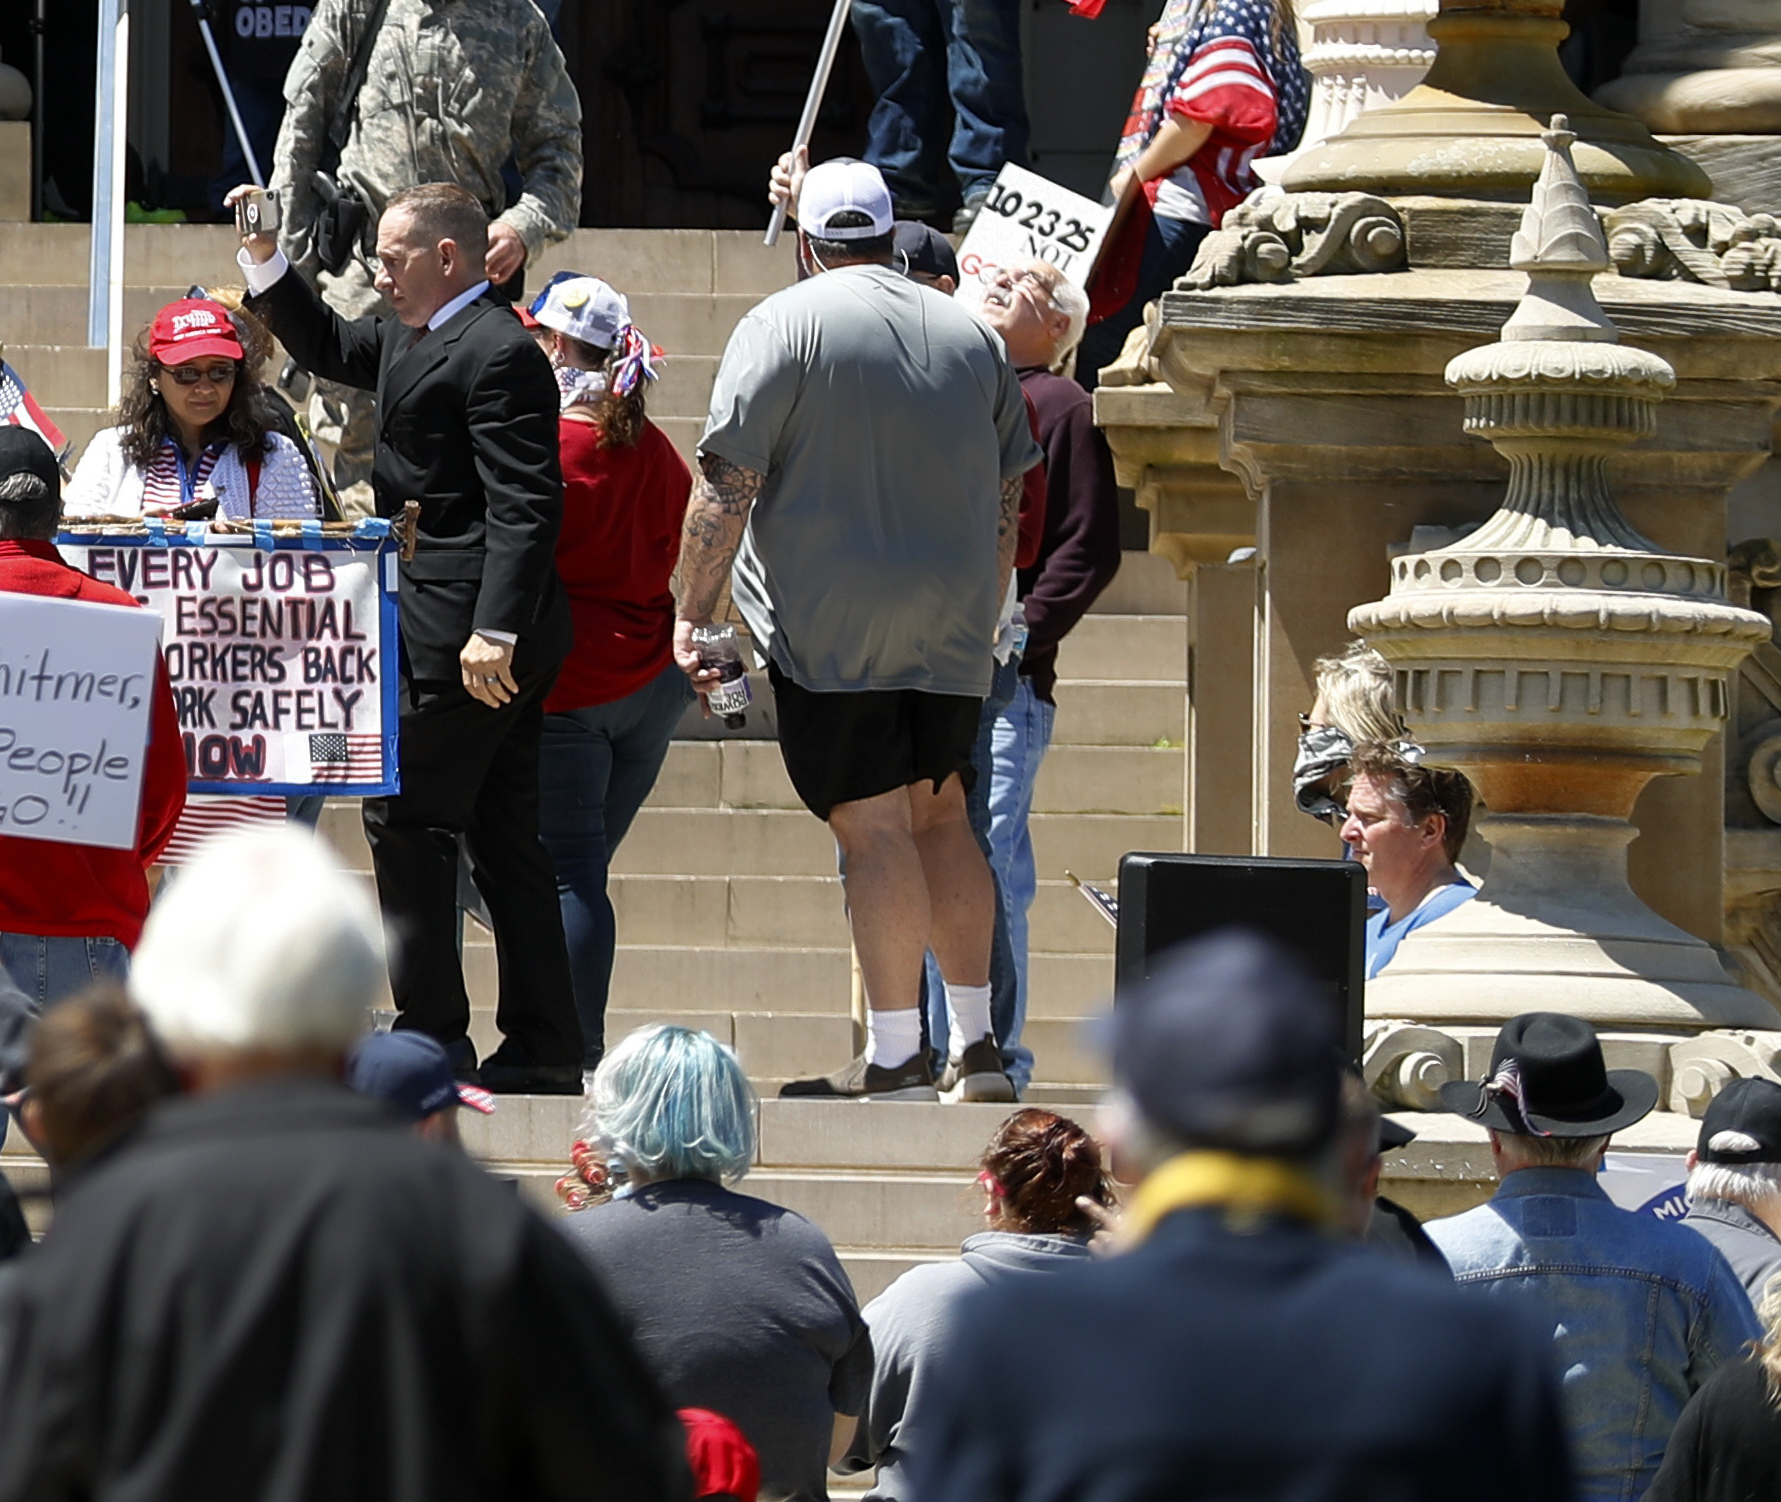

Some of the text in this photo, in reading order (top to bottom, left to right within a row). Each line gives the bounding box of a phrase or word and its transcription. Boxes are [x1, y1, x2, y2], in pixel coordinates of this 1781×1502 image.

[88, 547, 337, 594] EVERY JOB
[175, 595, 367, 642] ESSENTIAL
[164, 642, 378, 686] ORKERS BACK
[228, 686, 364, 732] SAFELY
